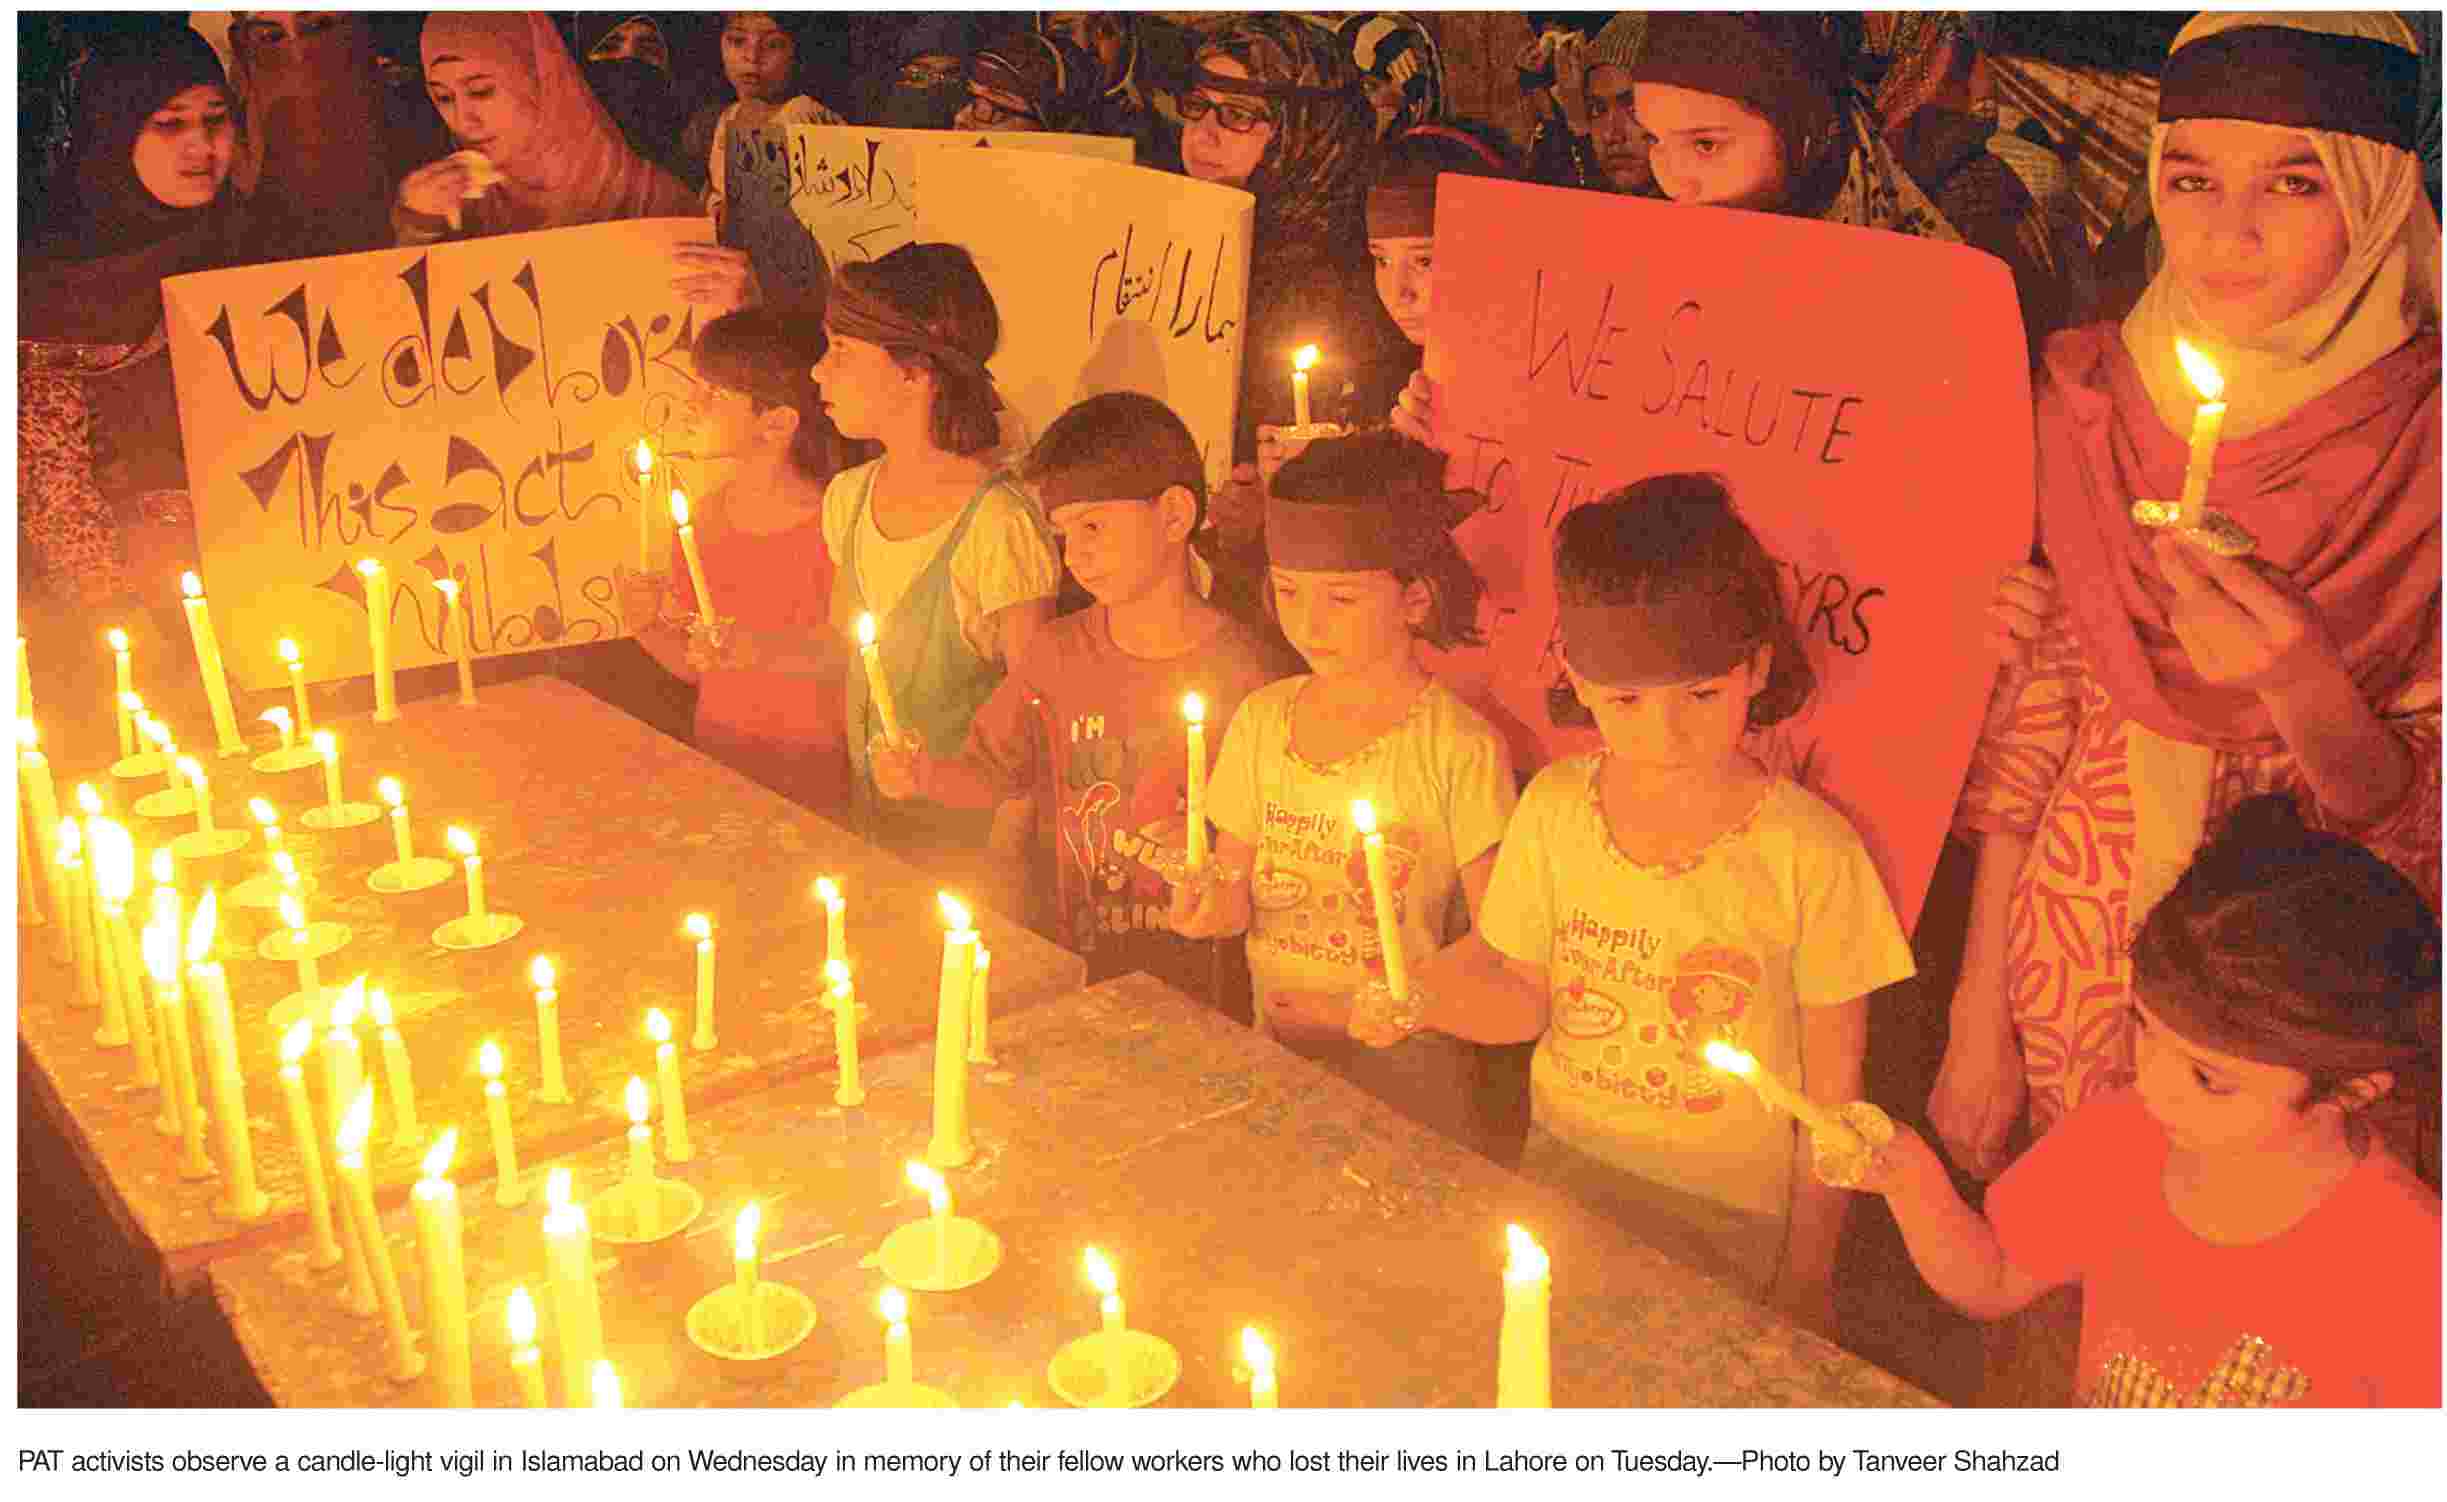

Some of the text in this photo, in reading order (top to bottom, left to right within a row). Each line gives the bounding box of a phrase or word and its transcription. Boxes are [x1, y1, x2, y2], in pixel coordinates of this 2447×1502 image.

[204, 282, 367, 412] We
[1528, 269, 1864, 465] WE SALUTE
[1265, 801, 1337, 841] Happily
[1567, 908, 1662, 960] Happily
